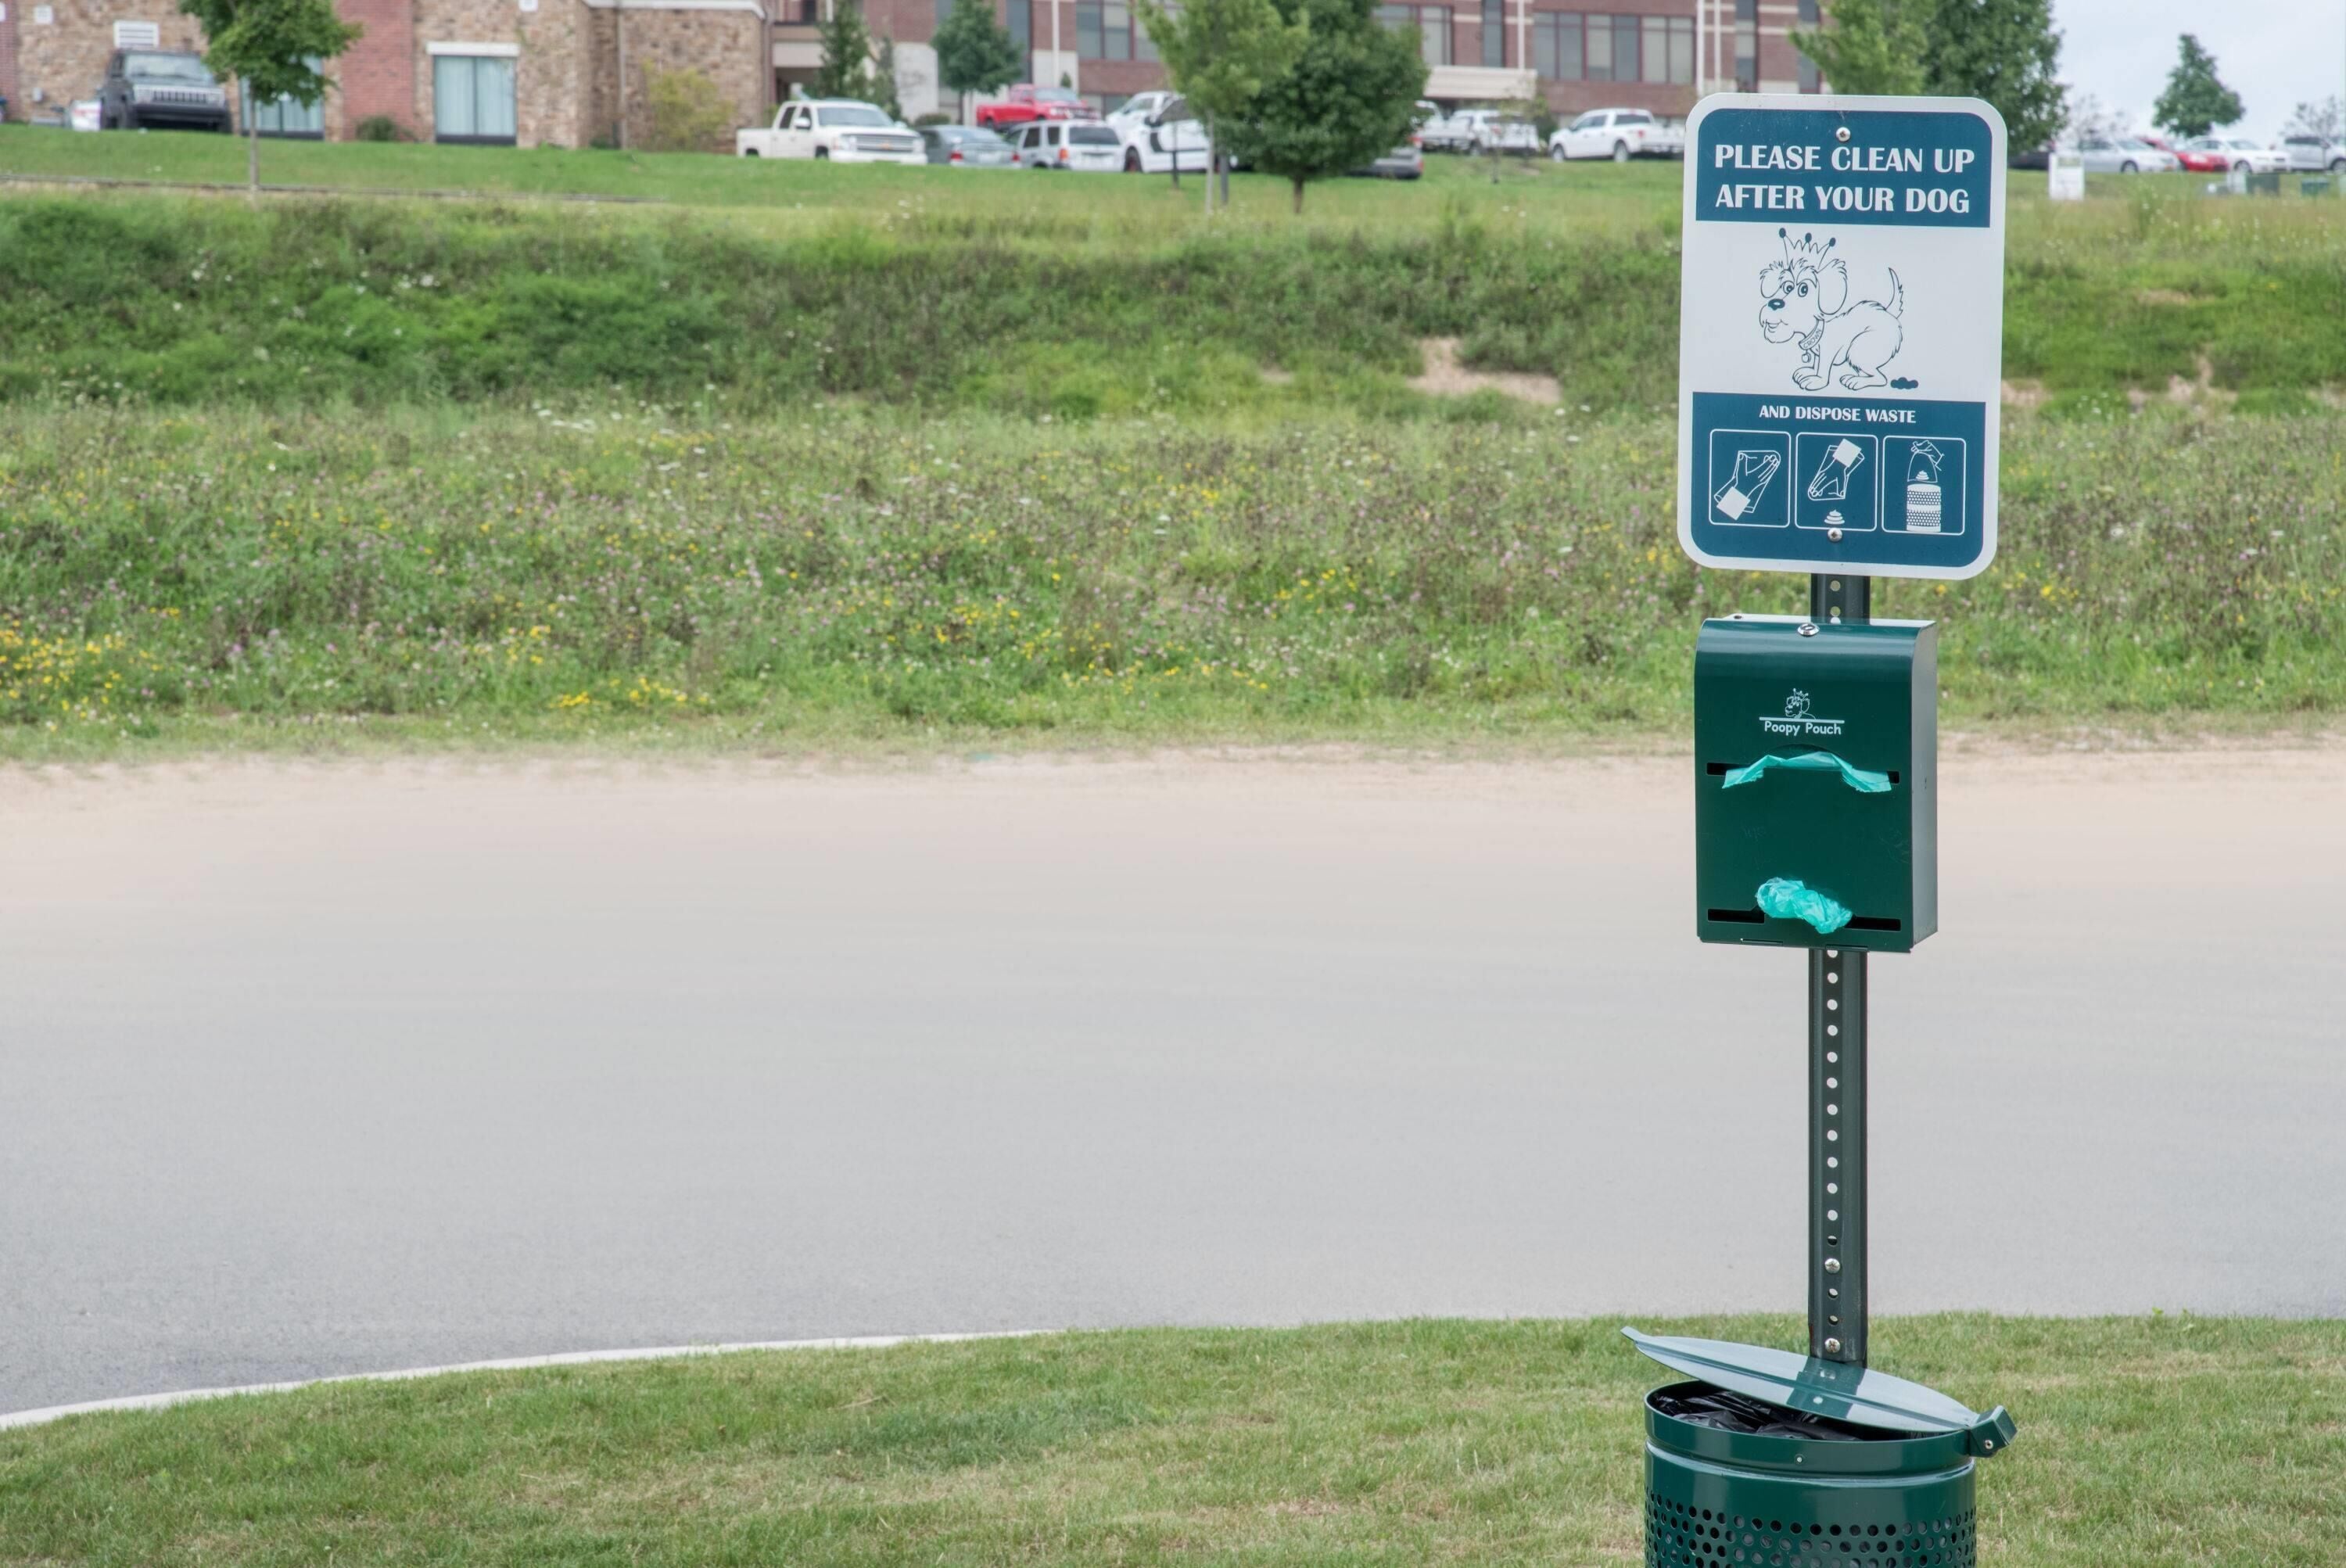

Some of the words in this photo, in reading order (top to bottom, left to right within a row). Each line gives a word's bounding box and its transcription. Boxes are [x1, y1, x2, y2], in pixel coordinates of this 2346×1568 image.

[1715, 145, 1821, 170] PLEASE
[1831, 146, 1923, 173] CLEAN
[1934, 149, 1975, 174] UP
[1715, 184, 1805, 210] AFTER
[1814, 186, 1895, 213] YOUR
[1905, 188, 1971, 213] DOG
[1803, 328, 1822, 349] CROWN
[1759, 405, 1791, 419] AND
[1795, 406, 1861, 422] DISPOSE
[1865, 409, 1917, 424] WASTE
[1764, 720, 1800, 737] Poopy
[1805, 723, 1842, 735] Pouch
